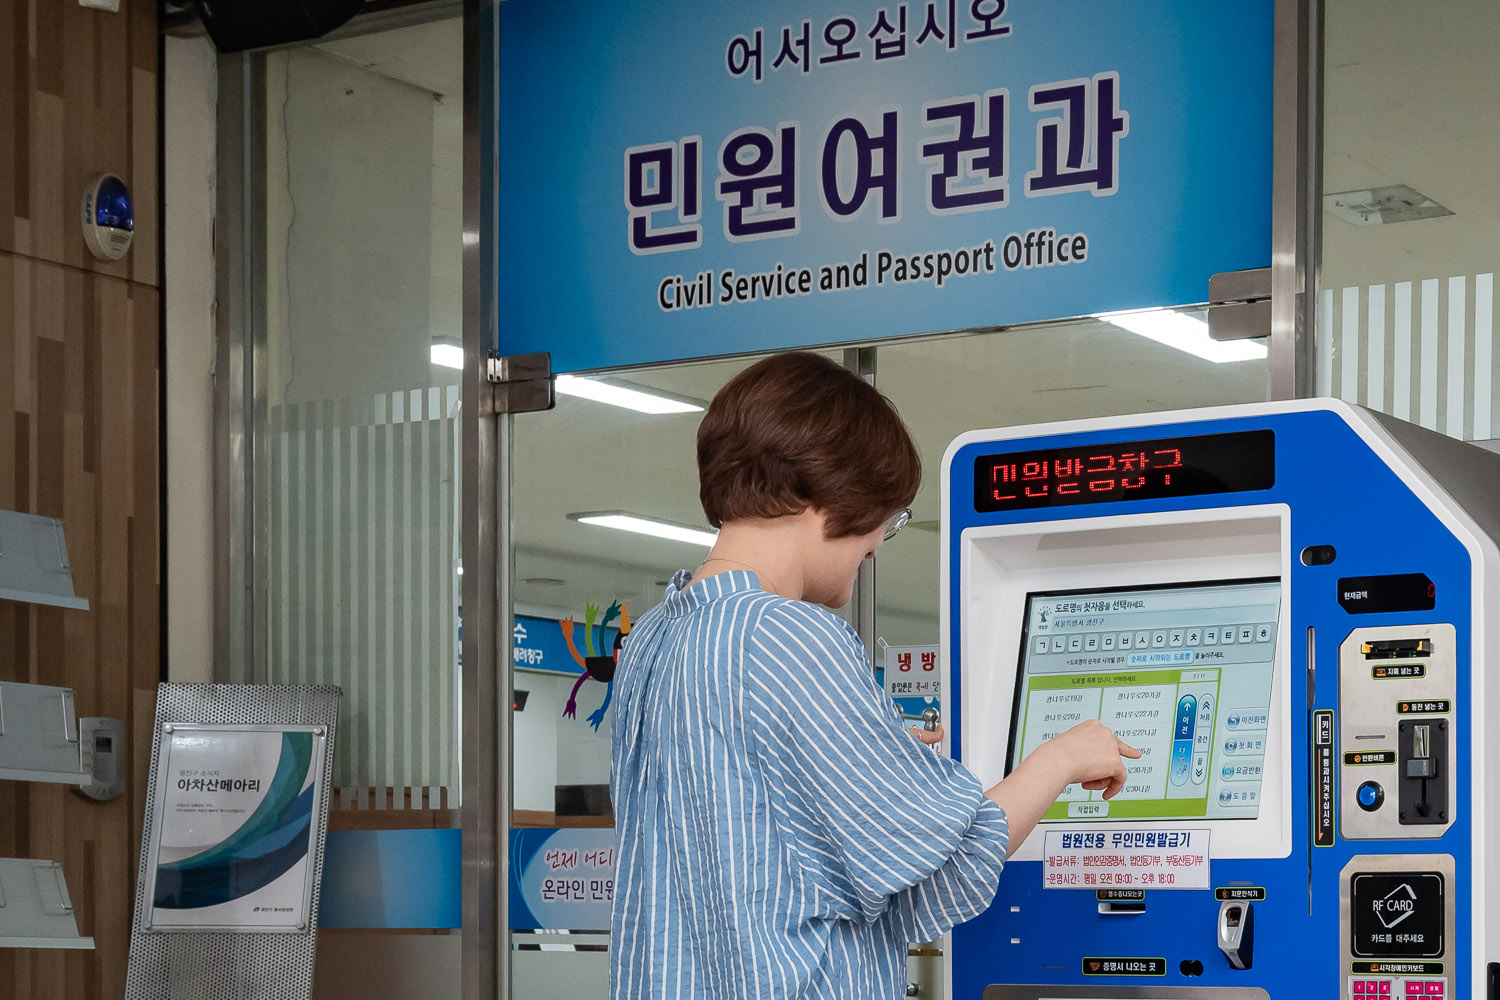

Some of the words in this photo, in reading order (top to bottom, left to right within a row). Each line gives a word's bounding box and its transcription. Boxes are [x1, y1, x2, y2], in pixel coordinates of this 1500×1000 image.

[727, 0, 1012, 80] 어서오십시오
[626, 74, 1125, 250] 민원여권과
[659, 276, 713, 312] Civil
[720, 264, 811, 305] Service
[819, 254, 868, 290] and
[877, 241, 994, 286] Passport
[1002, 231, 1087, 269] Office
[1055, 603, 1082, 613] 도로명의
[1112, 600, 1146, 610] 선택하세요.
[178, 778, 260, 793] 아차산메아리
[1062, 833, 1106, 849] 법원전용
[1111, 832, 1191, 848] 무인민원발급기
[546, 849, 577, 869] 언제
[583, 848, 613, 869] 어디
[1084, 873, 1097, 884] 평일
[1099, 873, 1113, 884] 오전
[1115, 873, 1132, 884] 09:00
[1141, 873, 1155, 884] 오후
[1158, 873, 1175, 884] 18:00
[542, 879, 585, 901] 온라인
[1373, 900, 1384, 911] RF
[1387, 900, 1413, 911] CARD
[1371, 934, 1392, 943] 카드를
[1102, 962, 1124, 971] 증명서
[1125, 962, 1147, 972] 나오는
[1149, 963, 1156, 972] 곳
